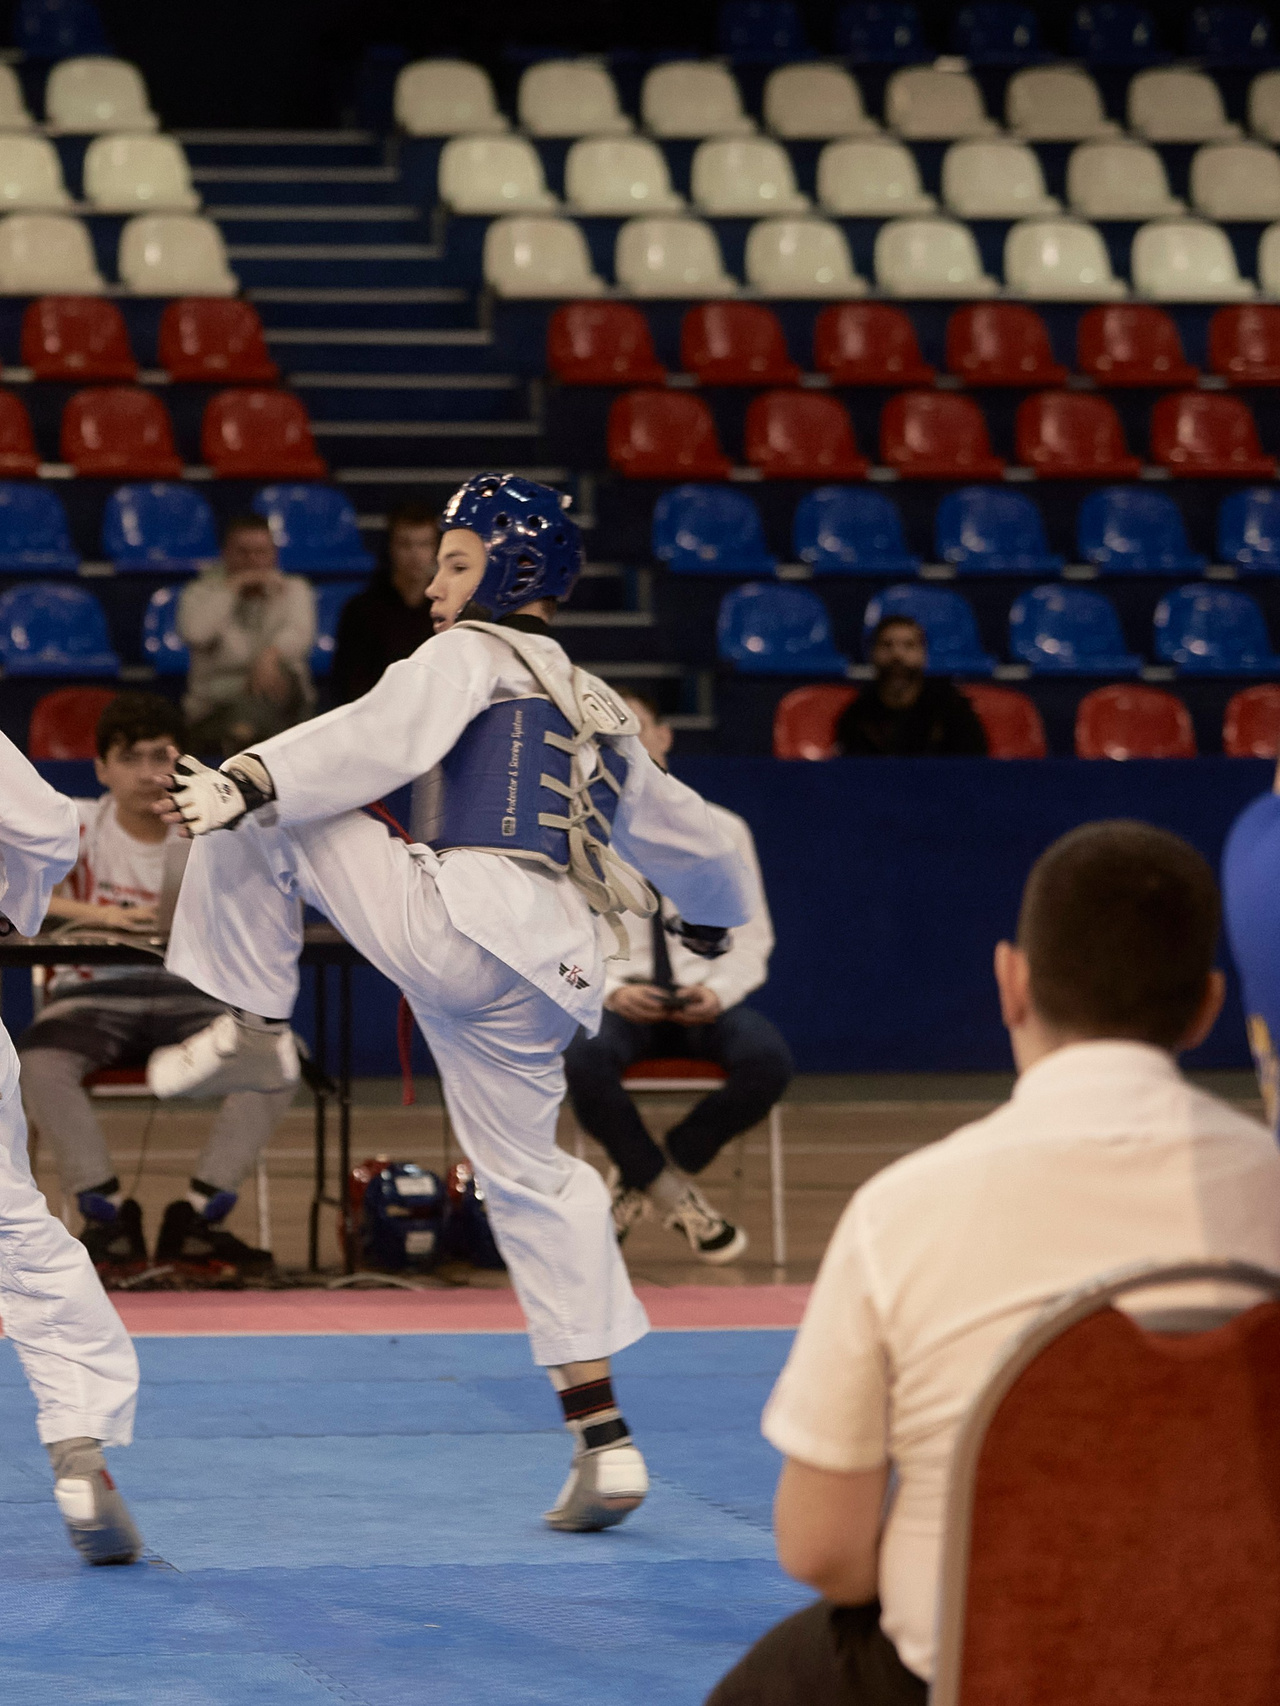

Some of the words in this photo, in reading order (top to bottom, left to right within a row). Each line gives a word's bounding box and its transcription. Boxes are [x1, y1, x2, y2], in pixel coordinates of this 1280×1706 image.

[511, 710, 524, 738] System
[509, 739, 523, 768] Scoring
[506, 778, 518, 814] Protector
